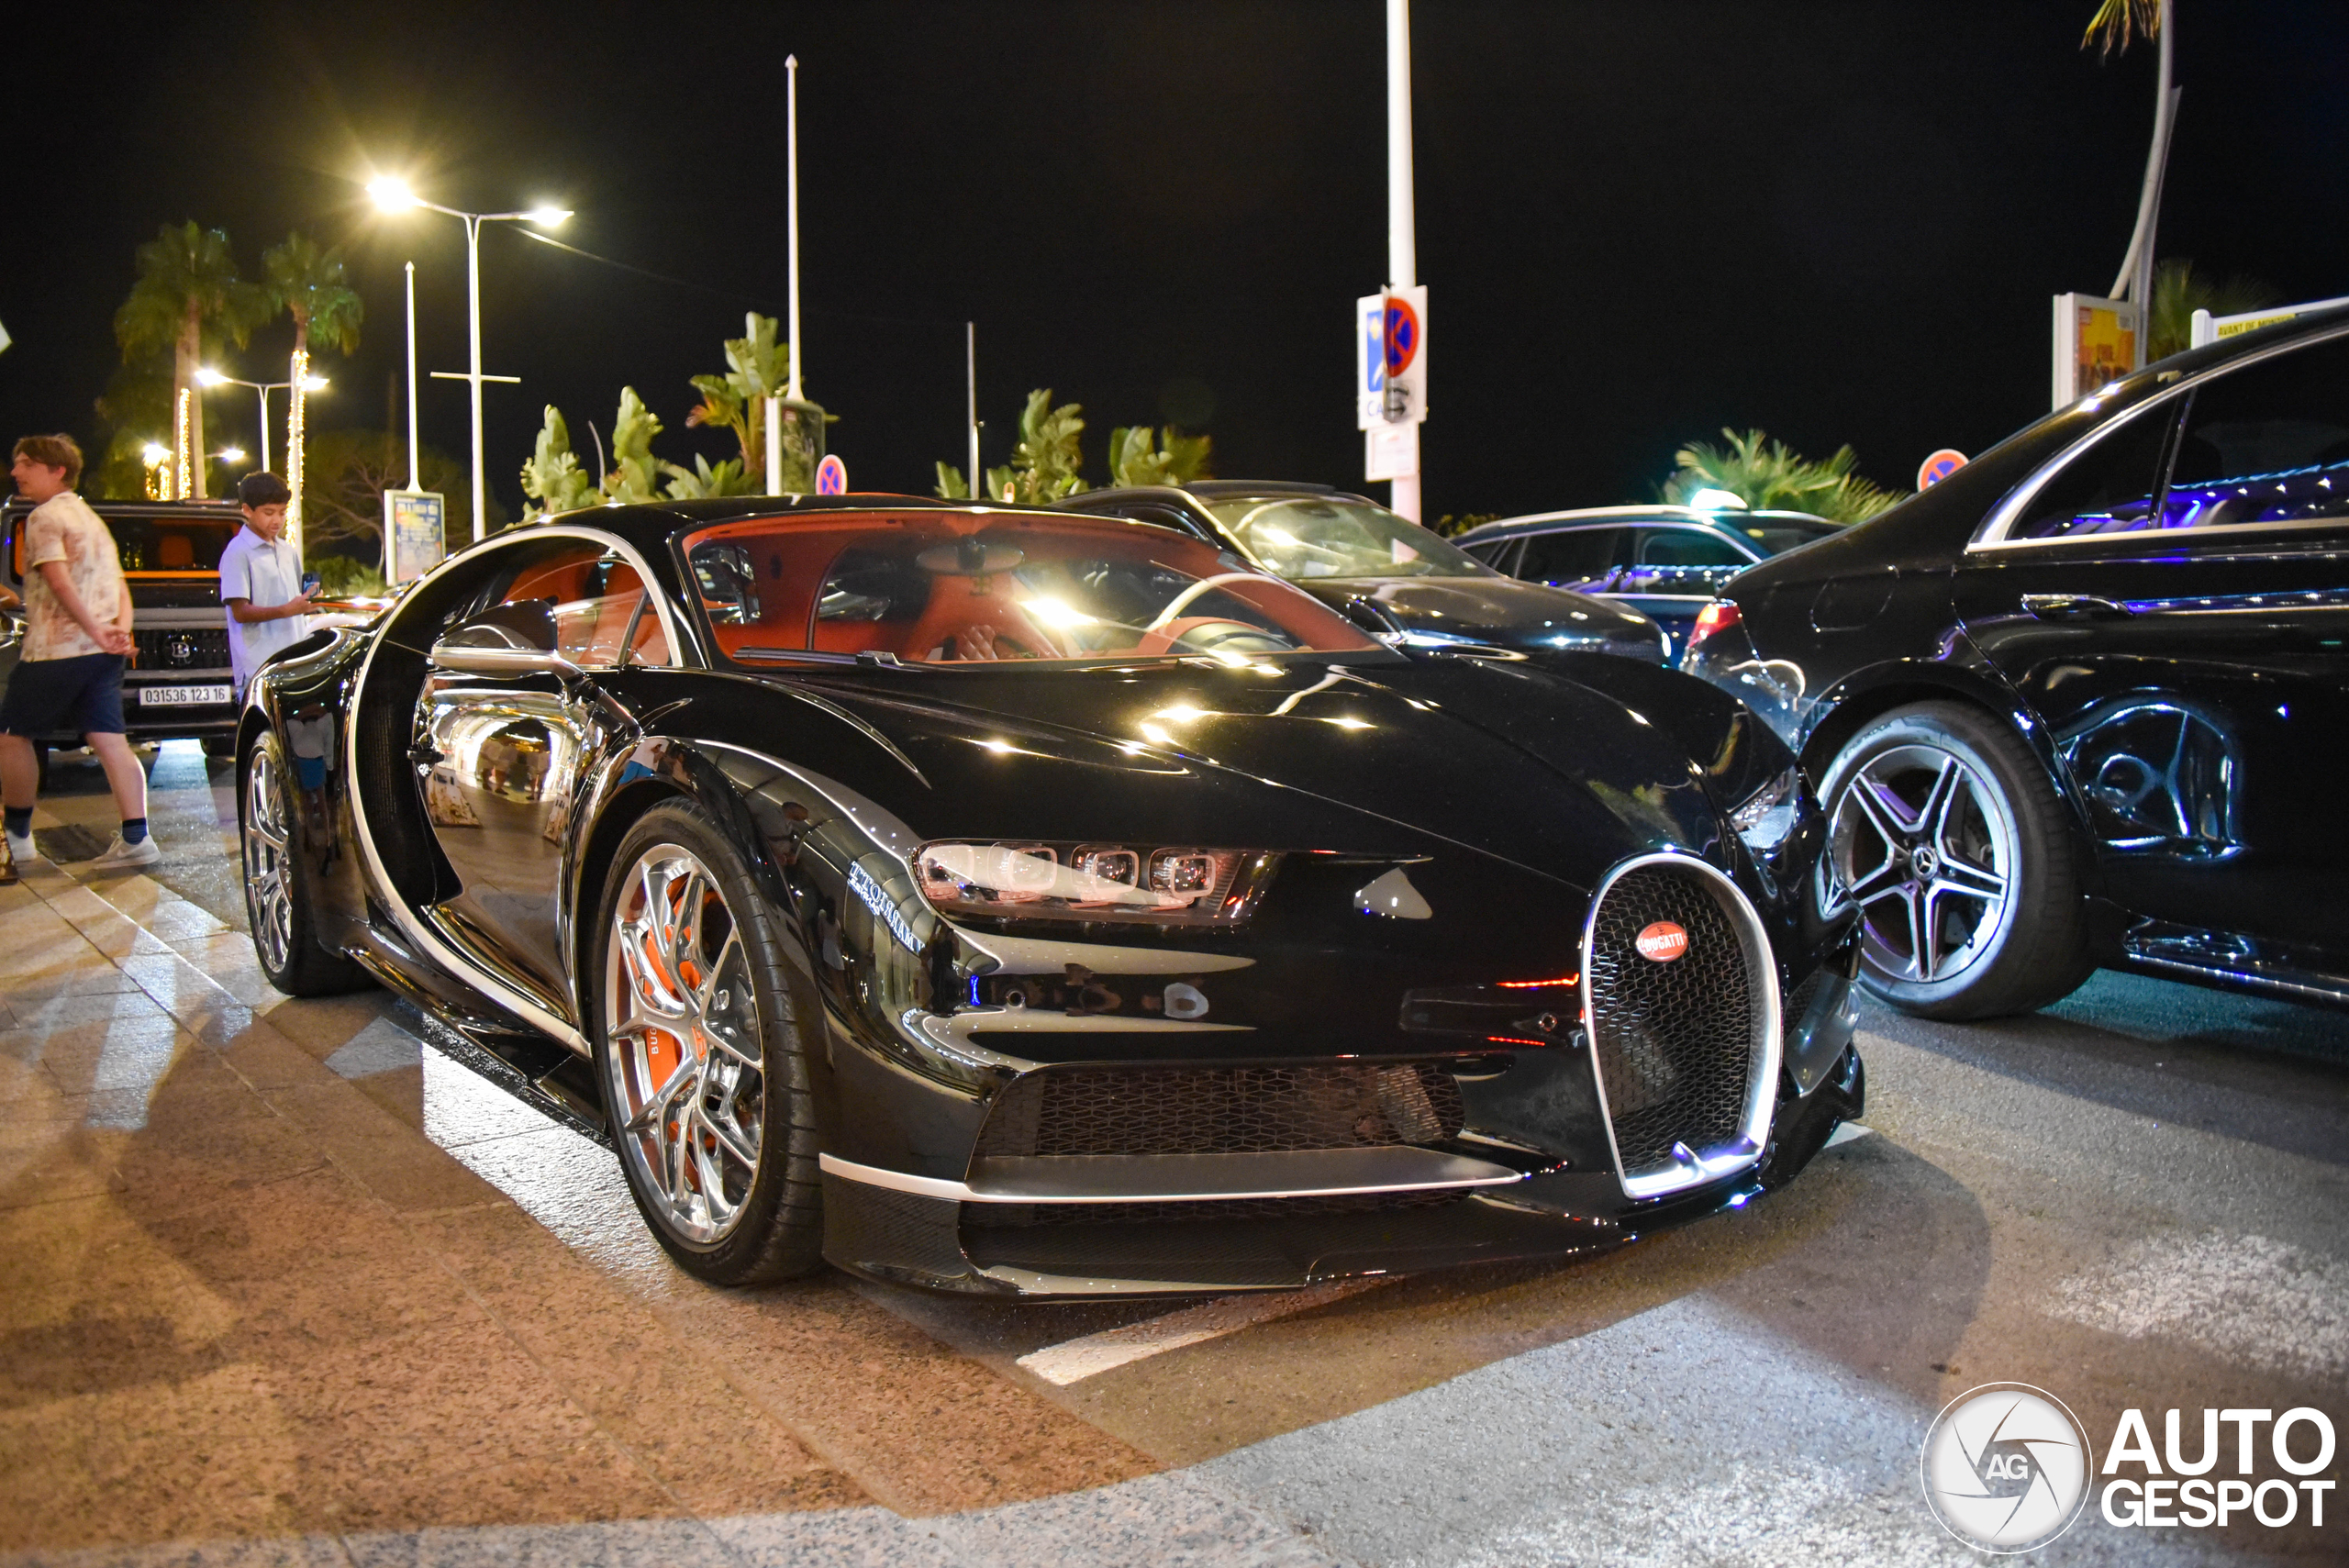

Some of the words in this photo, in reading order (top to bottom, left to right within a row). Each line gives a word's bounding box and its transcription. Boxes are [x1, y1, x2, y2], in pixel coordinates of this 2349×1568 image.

[2219, 324, 2243, 336] AVANT
[145, 690, 186, 703] 031536
[191, 688, 209, 702] 123
[213, 687, 225, 701] 16
[1643, 932, 1685, 953] BUGATTI
